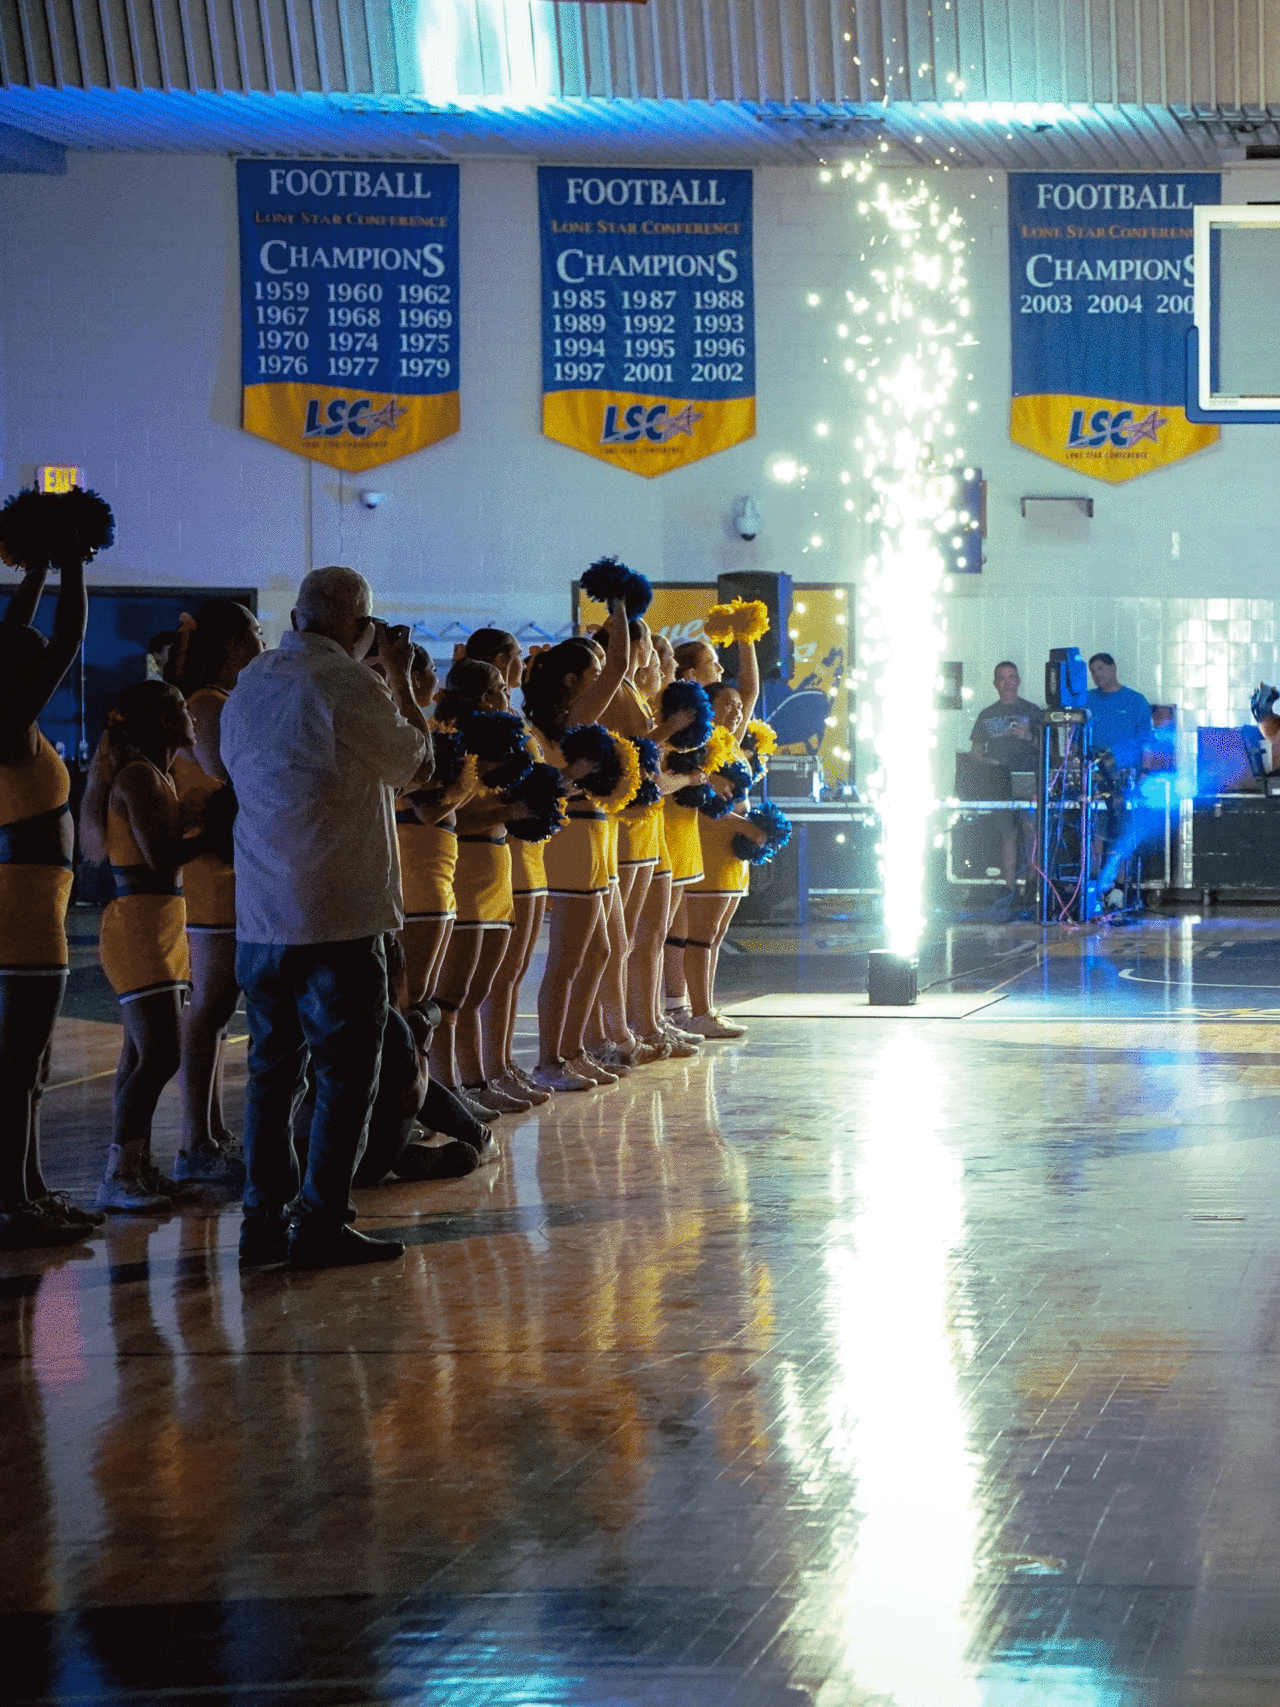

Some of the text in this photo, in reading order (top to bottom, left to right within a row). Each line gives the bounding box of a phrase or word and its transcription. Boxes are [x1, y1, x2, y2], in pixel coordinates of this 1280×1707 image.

[269, 168, 432, 199] FOOTBALL
[566, 177, 726, 206] FOOTBALL
[1036, 183, 1193, 210] FOOTBALL
[254, 210, 448, 228] LONE STAR CONFERENCE
[551, 219, 740, 236] LONE STAR CONFERENCE
[1021, 224, 1061, 239] LONE
[1067, 225, 1107, 239] STAR
[259, 239, 446, 278] CHAMPIONS
[556, 248, 738, 284] CHAMPIONS
[254, 281, 451, 305] 1959 1960 1962
[552, 289, 745, 310] 1985 1987 1988
[1020, 294, 1194, 314] 2003 2004 200
[256, 305, 452, 329] 1967 1968 1969
[553, 313, 744, 334] 1989 1992 1993
[257, 330, 450, 353] 1970 1974 1975
[554, 337, 745, 358] 1994 1995 1996
[257, 354, 451, 378] 1976 1977 1979
[554, 362, 744, 382] 1997 2001 2002
[303, 397, 372, 438] LSC
[600, 403, 668, 444] LSC
[1066, 409, 1134, 449] LSC
